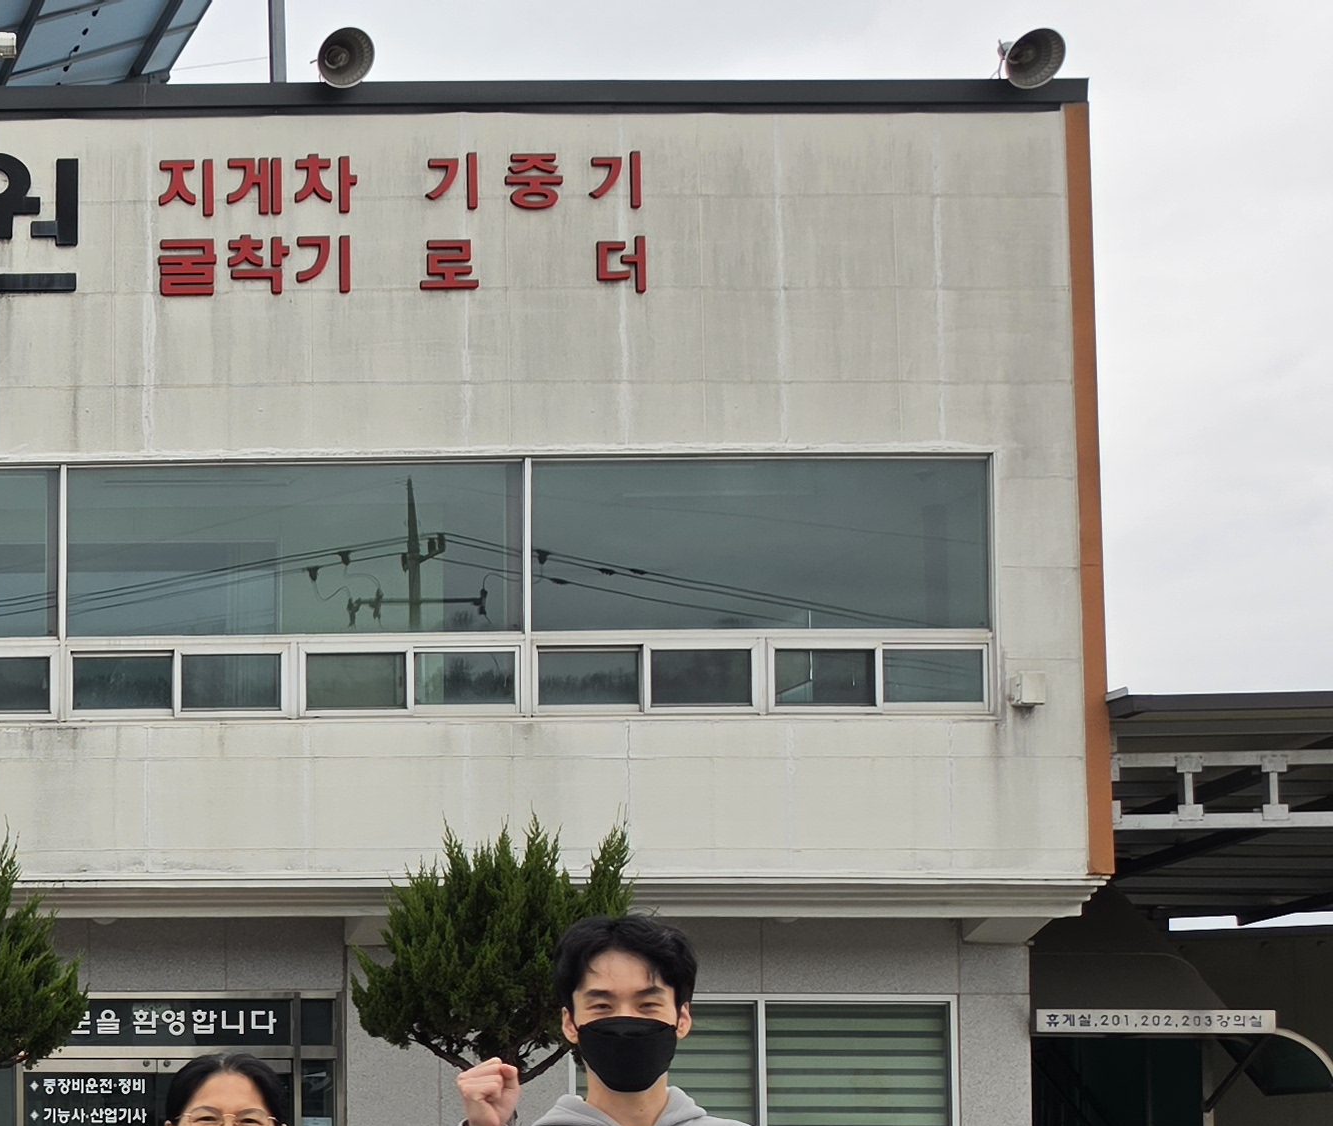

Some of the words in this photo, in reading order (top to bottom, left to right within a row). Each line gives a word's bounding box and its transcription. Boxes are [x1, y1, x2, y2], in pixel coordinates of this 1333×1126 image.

[158, 153, 358, 217] 지게차
[424, 151, 642, 210] 기중기
[158, 234, 351, 296] 굴착기
[133, 1009, 277, 1036] 환영합니다
